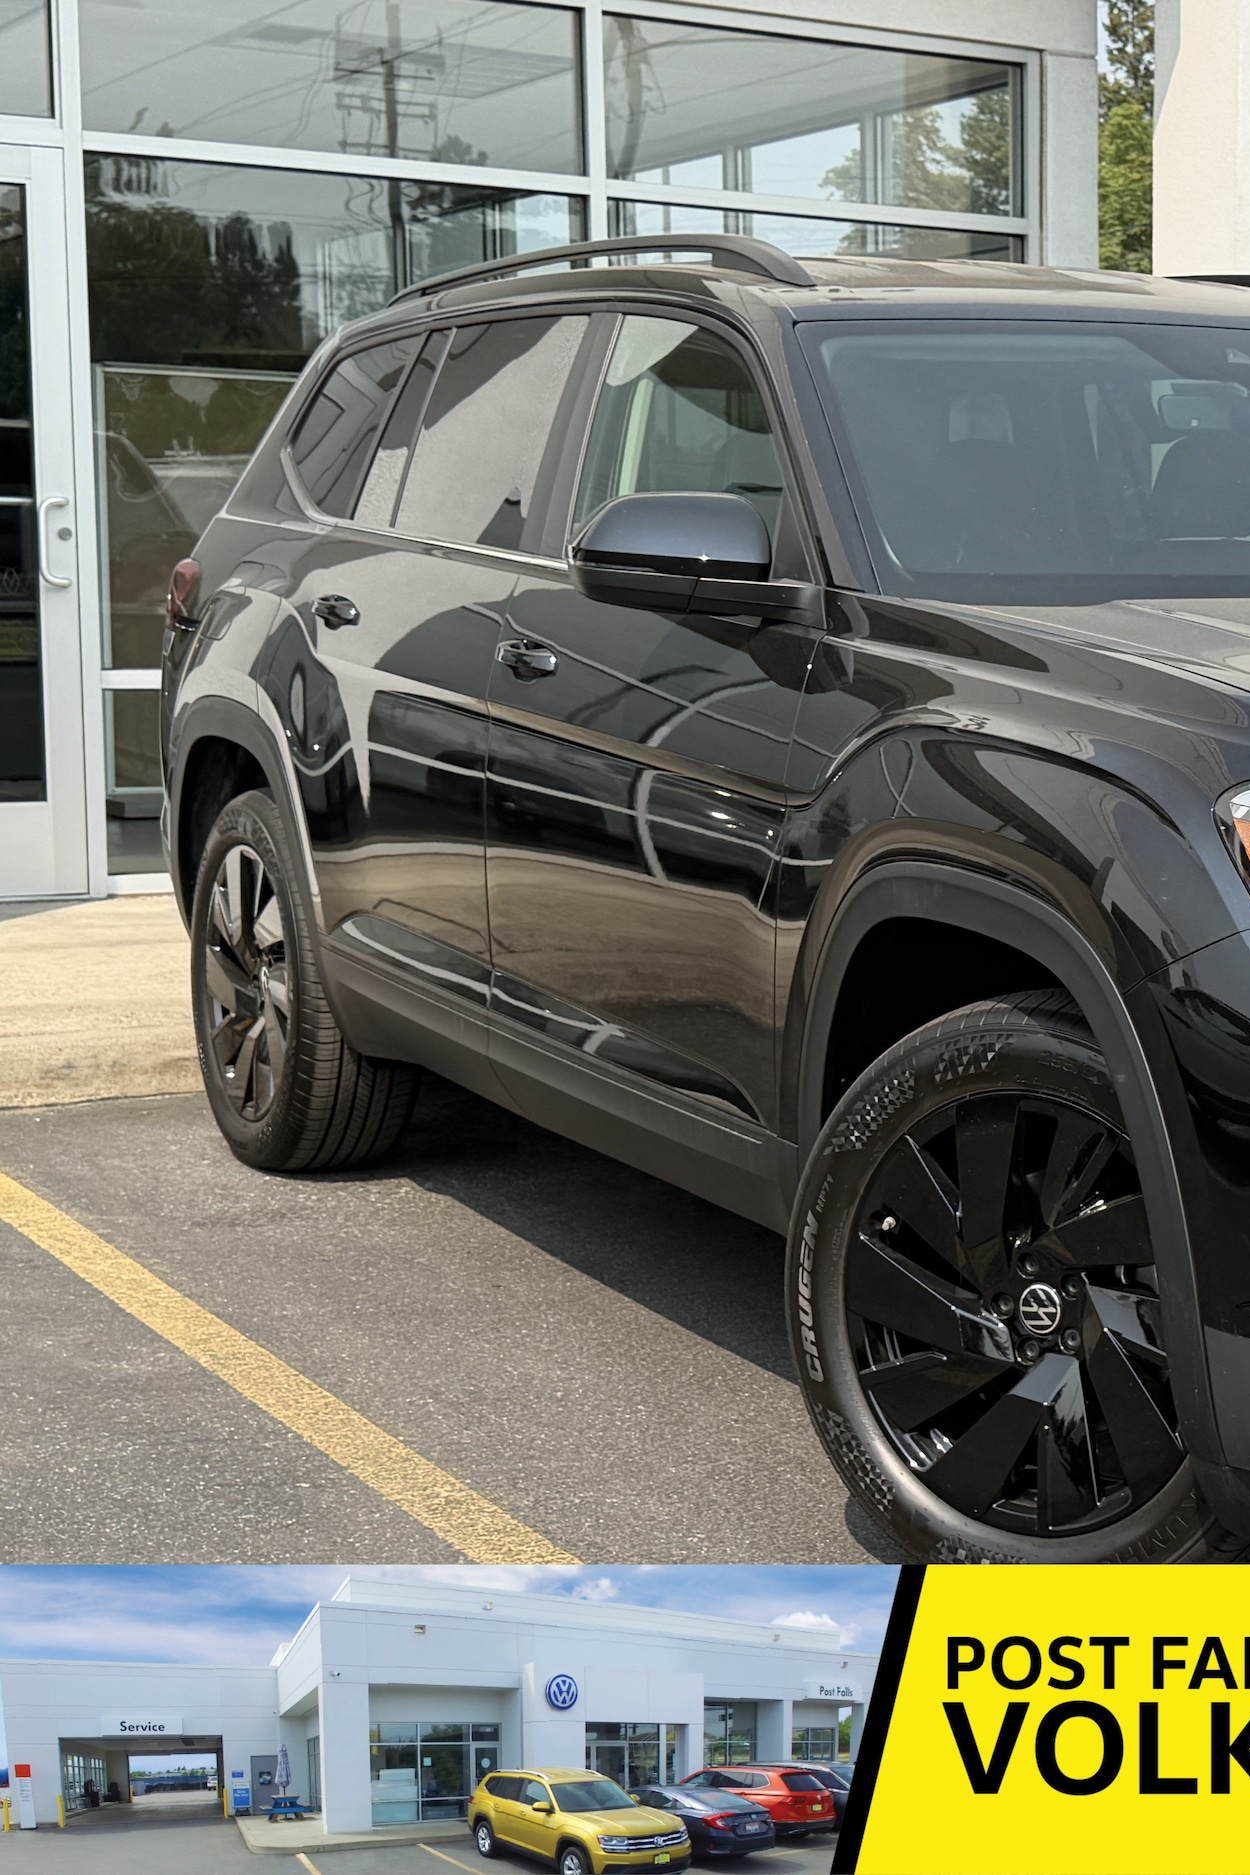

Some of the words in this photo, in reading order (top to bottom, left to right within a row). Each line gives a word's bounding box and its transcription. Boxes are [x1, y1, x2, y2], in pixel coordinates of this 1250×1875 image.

[798, 1209, 825, 1384] CRUGEN
[1019, 1283, 1062, 1336] VW
[546, 1674, 579, 1710] VW
[819, 1685, 835, 1697] Post
[836, 1686, 854, 1698] Falls
[119, 1720, 165, 1732] Service
